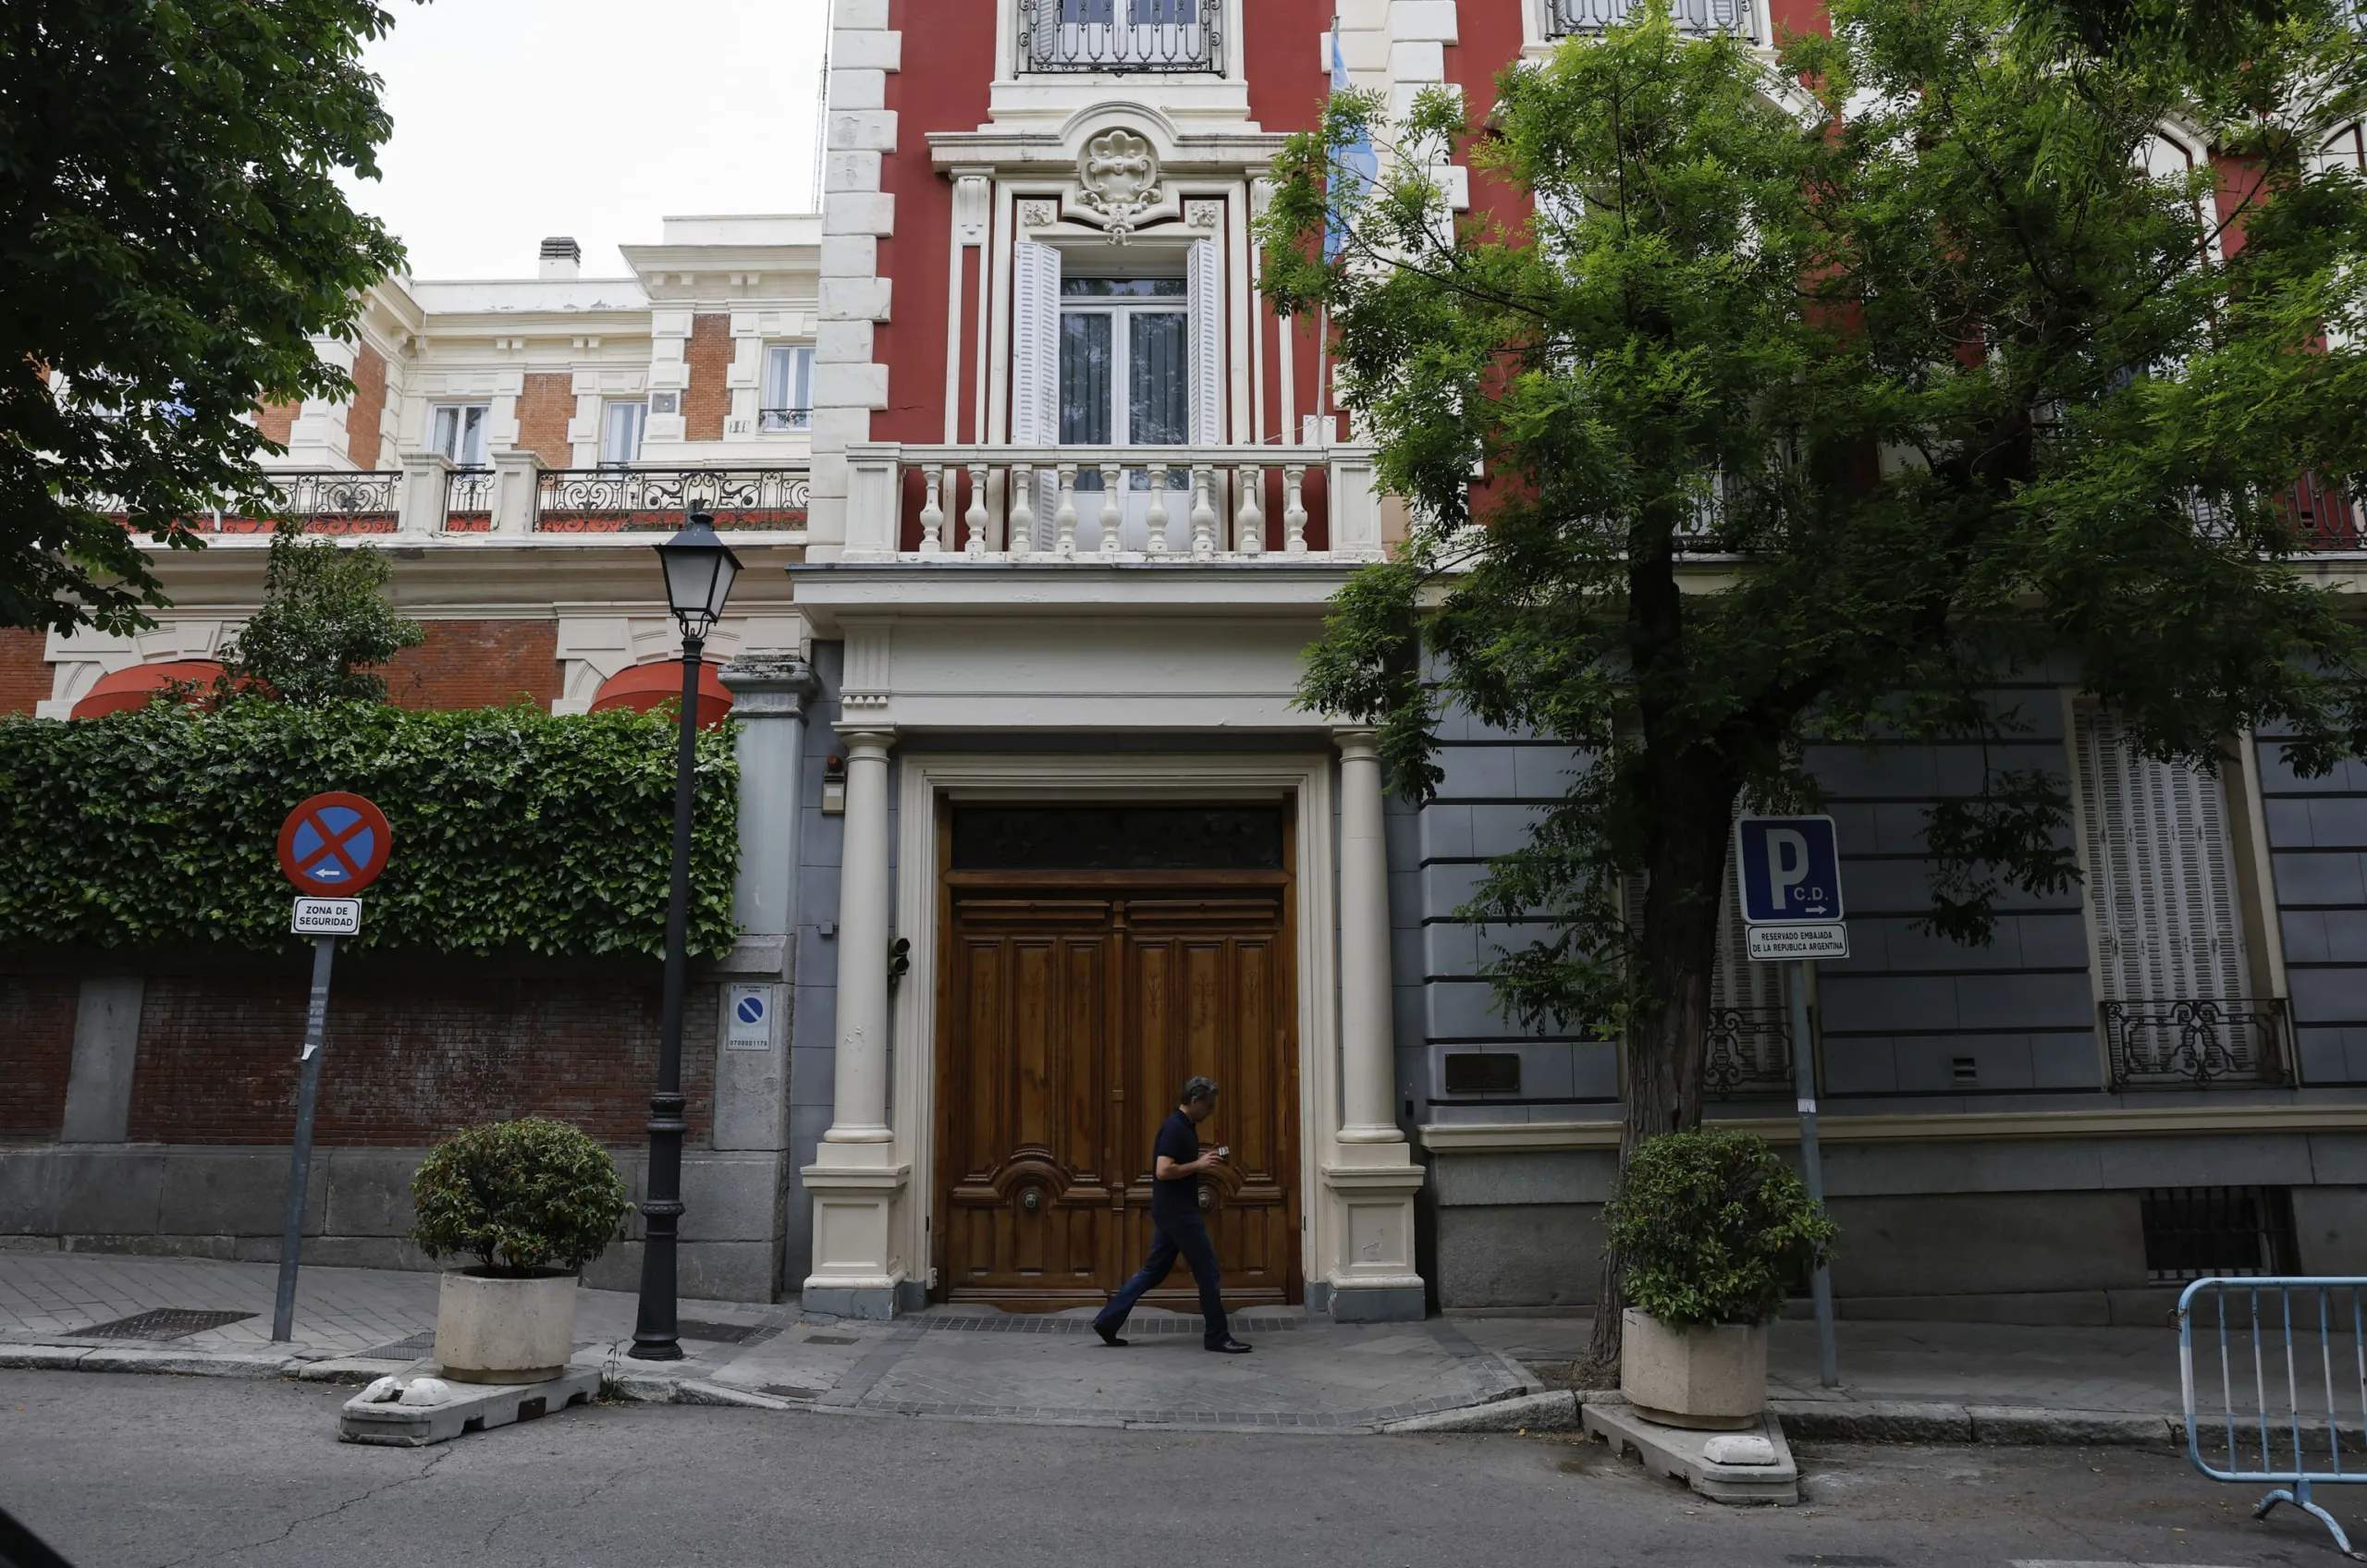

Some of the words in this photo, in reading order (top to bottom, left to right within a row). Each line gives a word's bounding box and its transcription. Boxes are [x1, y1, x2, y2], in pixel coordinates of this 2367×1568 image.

[1766, 828, 1809, 910] P
[1794, 887, 1829, 900] C.D.
[306, 906, 332, 914] ZONA
[336, 907, 348, 915] DE
[300, 917, 353, 926] SEGURIDAD
[1761, 932, 1798, 941] RESERVADO
[1800, 931, 1833, 940] EMBAJADA
[1752, 944, 1761, 952] DE
[1763, 944, 1772, 952] LA
[1773, 943, 1808, 951] REPUBLICA
[1809, 942, 1844, 950] ARGENTINA
